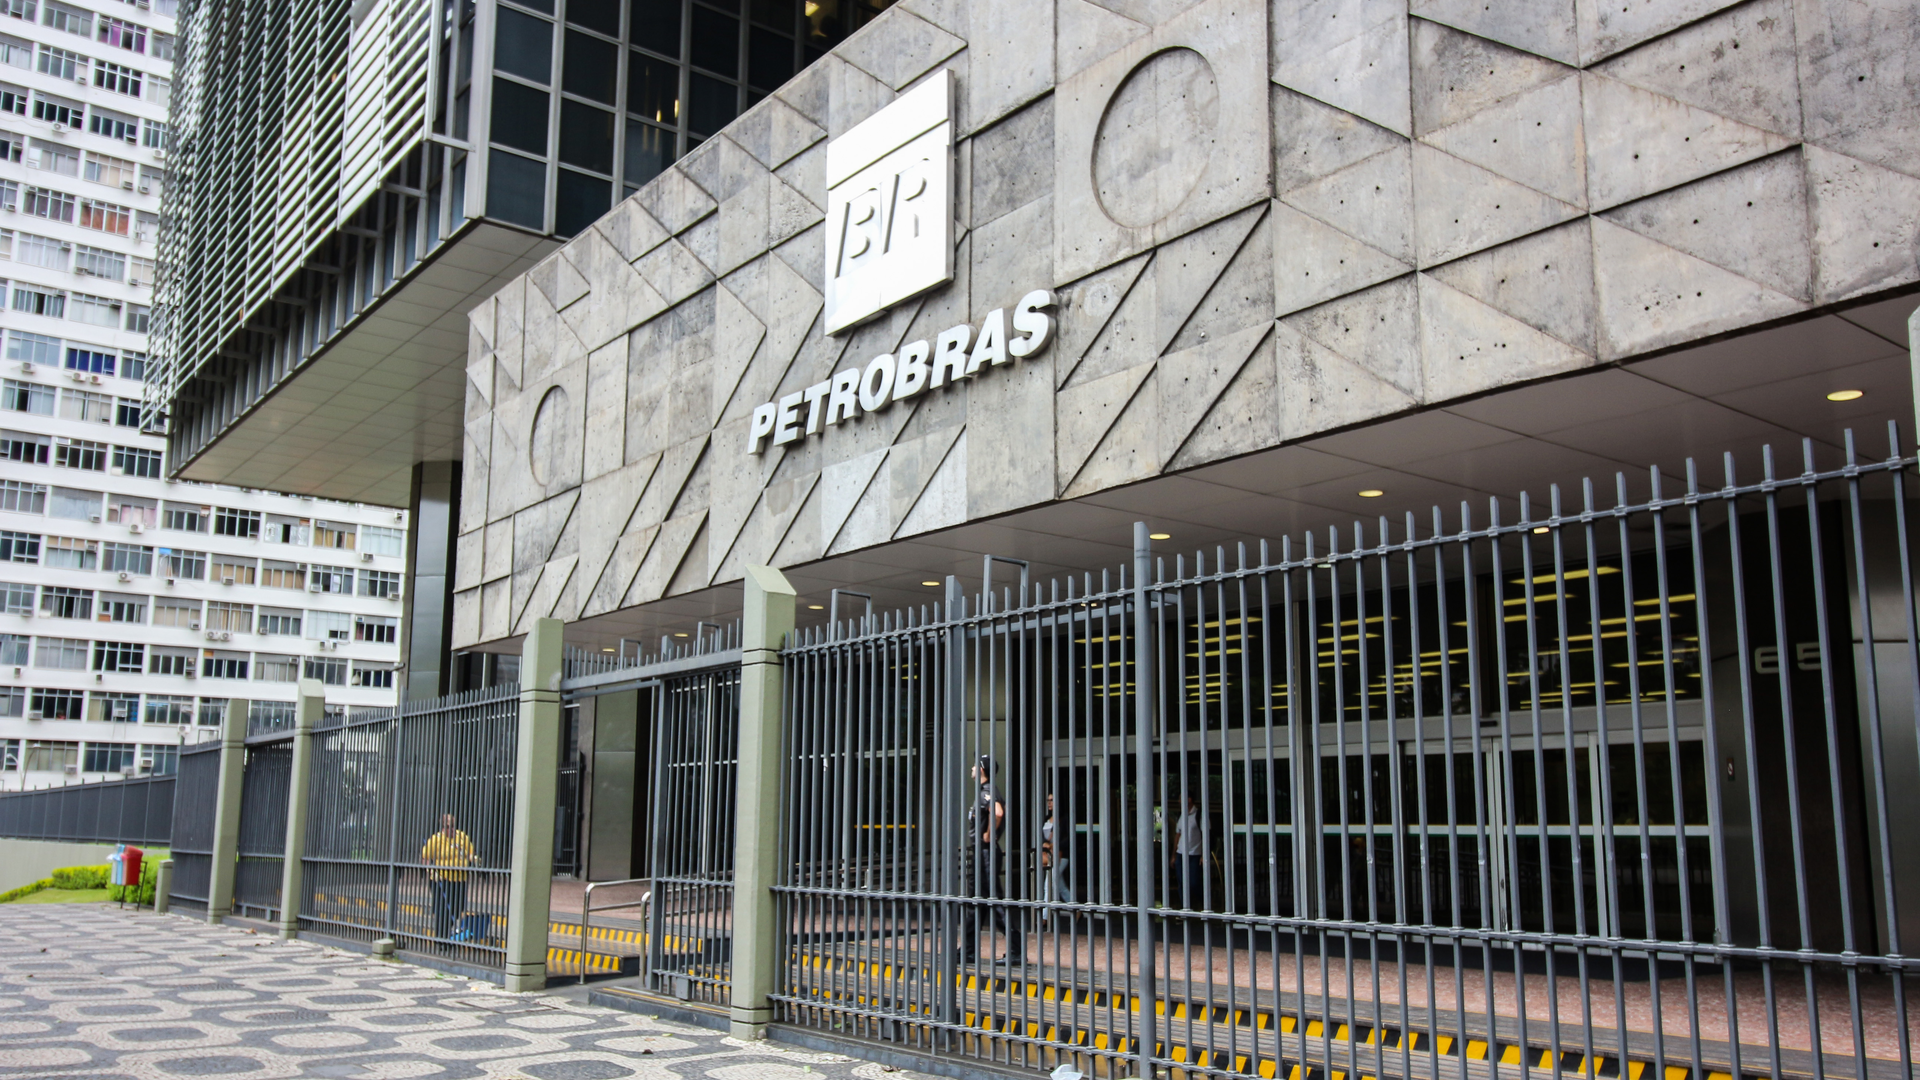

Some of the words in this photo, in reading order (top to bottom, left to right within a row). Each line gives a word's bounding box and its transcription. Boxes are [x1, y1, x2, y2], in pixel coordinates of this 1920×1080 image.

[835, 157, 931, 279] BR
[747, 290, 1058, 455] PETROBRAS
[1754, 641, 1824, 675] 65
